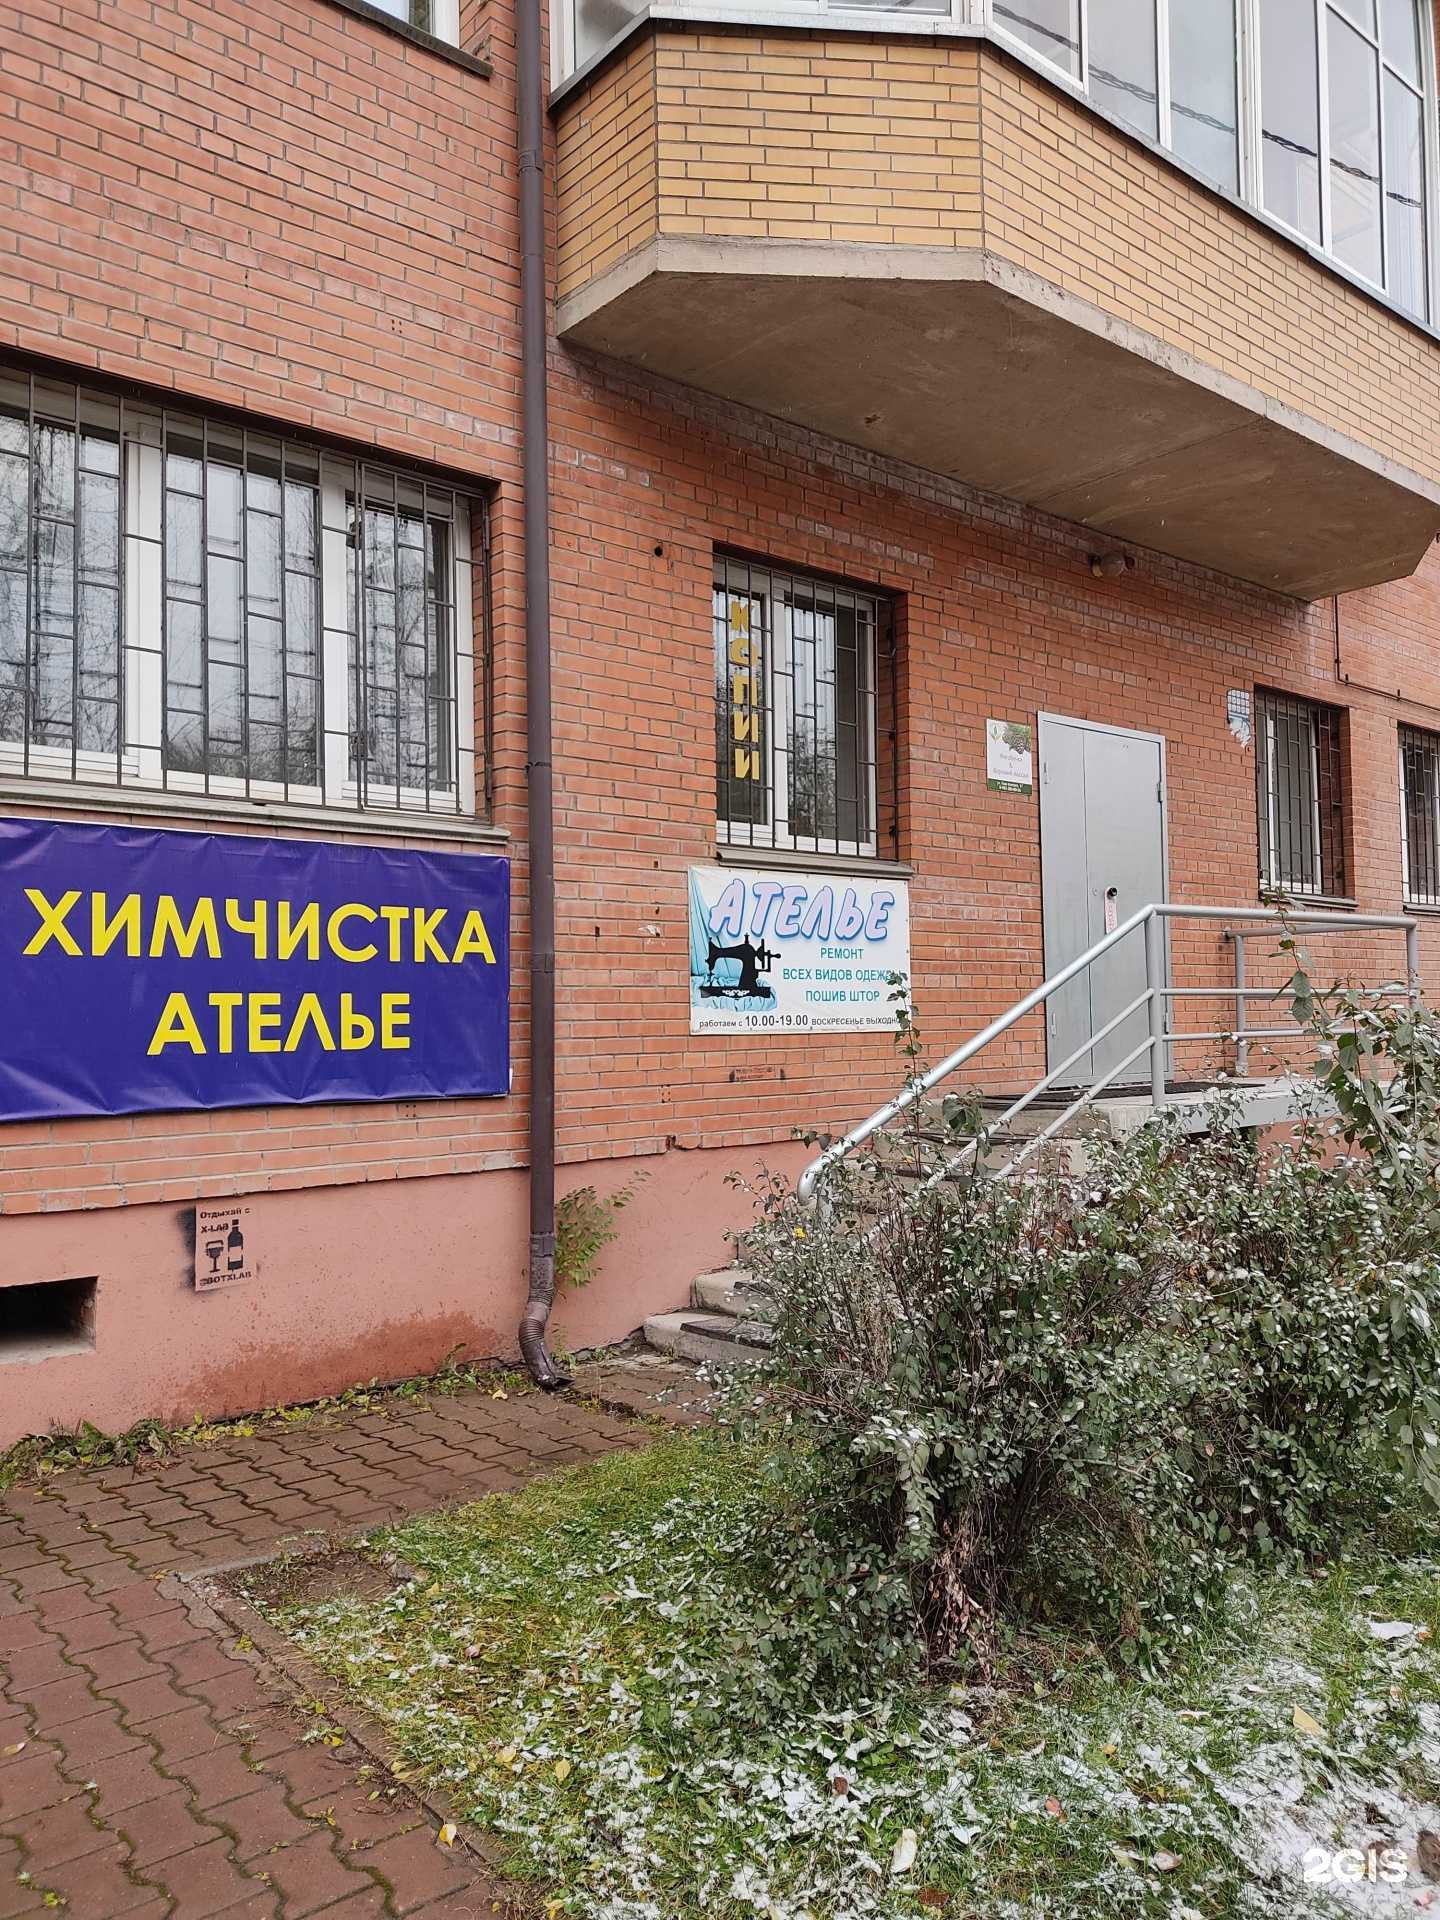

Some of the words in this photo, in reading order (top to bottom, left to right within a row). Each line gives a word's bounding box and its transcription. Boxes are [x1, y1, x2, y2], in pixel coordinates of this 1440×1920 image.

[730, 600, 760, 781] КОПИИ
[708, 878, 895, 941] АТЕЛЬЕ
[22, 888, 497, 964] ХИМЧИСТКА
[820, 947, 864, 960] РЕМОНТ
[783, 968, 812, 980] ВСЕХ
[815, 969, 852, 981] ВИДОВ
[855, 970, 902, 982] ОДЕЖД
[805, 991, 846, 1002] ПОШИВ
[849, 991, 880, 1002] ШТОР
[146, 993, 411, 1056] АТЕЛЬЕ
[700, 1019, 736, 1028] работаем
[745, 1014, 808, 1027] 10.00-19.00
[811, 1017, 865, 1026] ВОСКРЕСЕНЬЕ
[866, 1017, 901, 1026] ВЫХОДНО
[200, 1208, 242, 1219] Отдыхай
